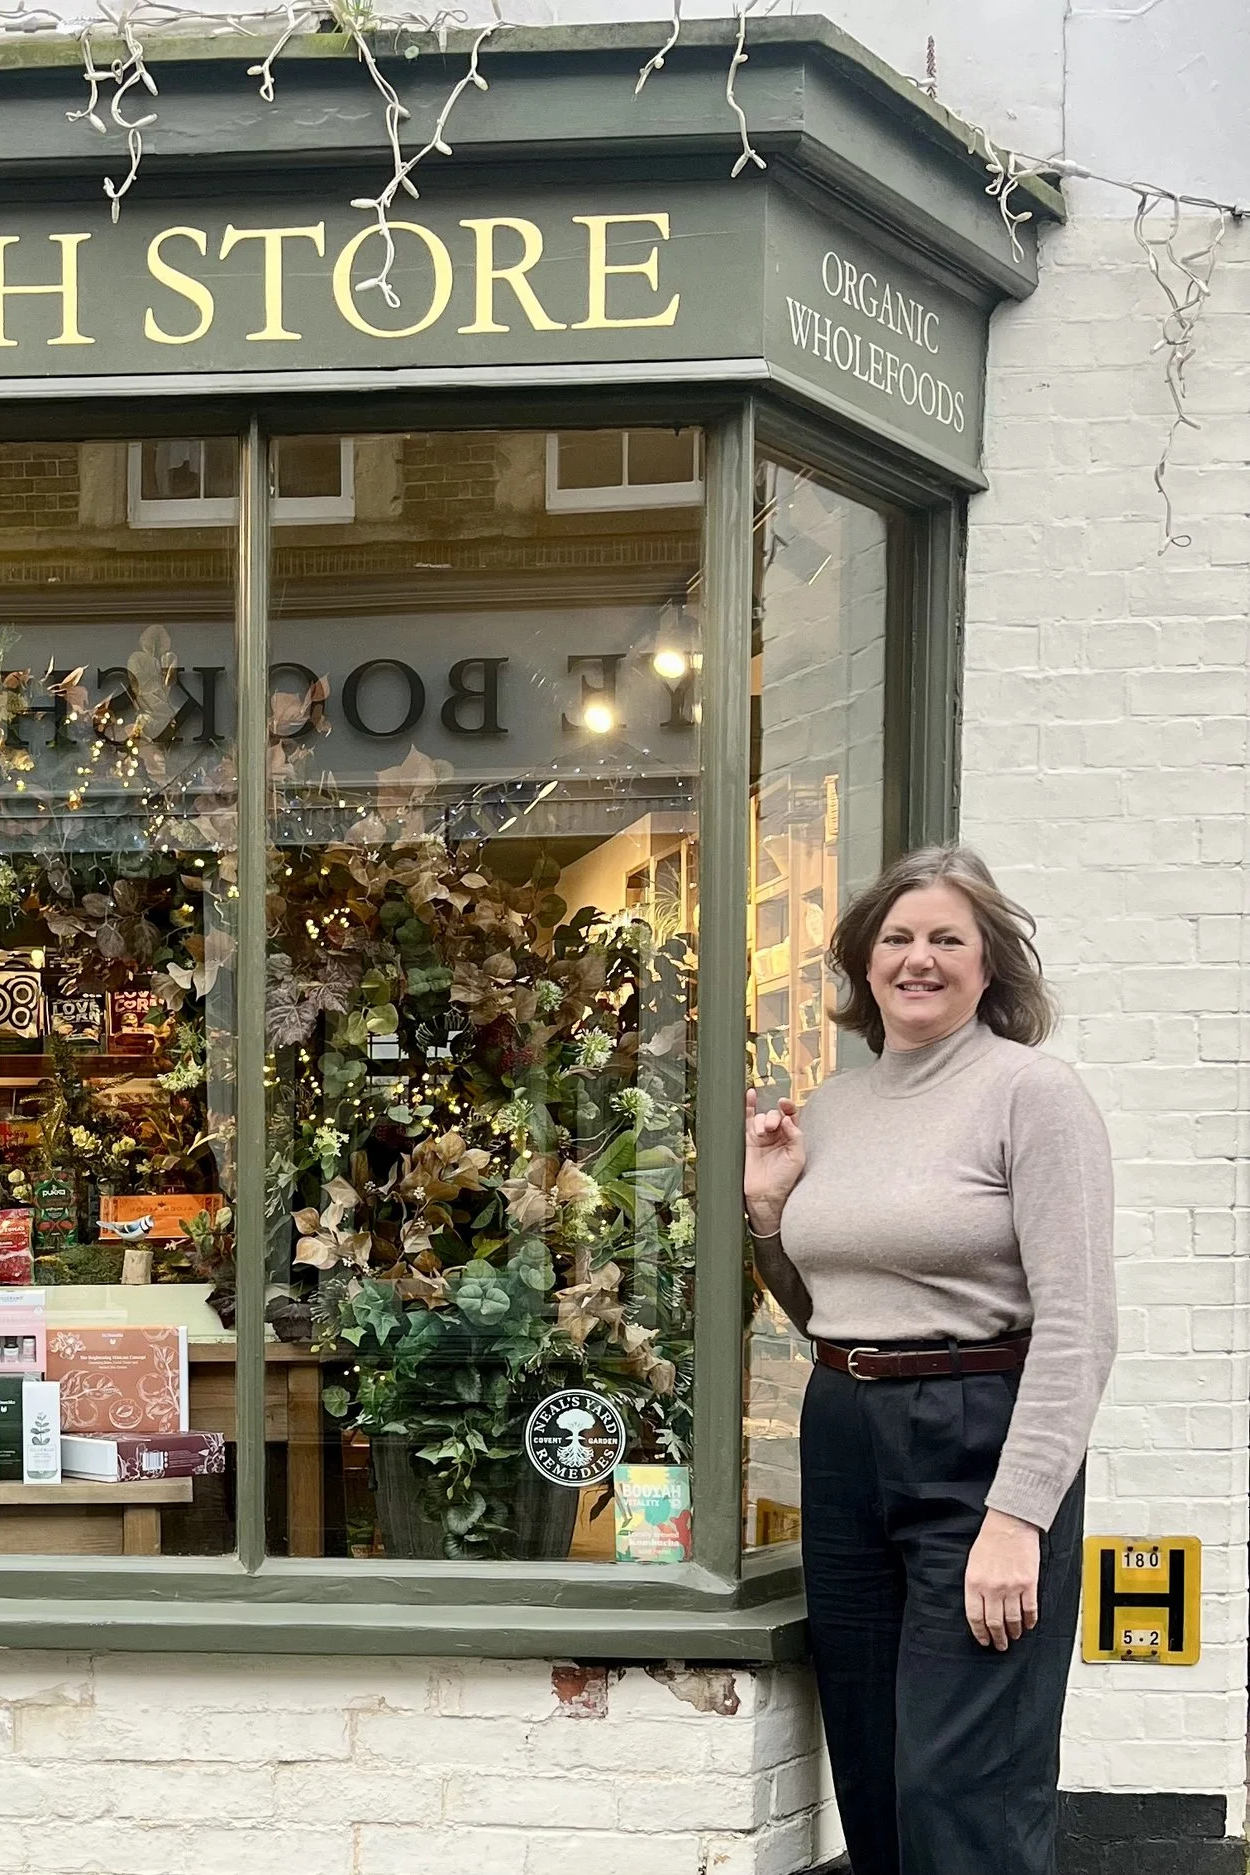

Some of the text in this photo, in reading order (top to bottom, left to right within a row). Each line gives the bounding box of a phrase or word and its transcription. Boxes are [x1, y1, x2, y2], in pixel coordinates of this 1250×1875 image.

[144, 211, 681, 345] STORE
[822, 251, 940, 354] ORGANIC
[786, 296, 965, 433] WHOLEFOODS
[534, 1396, 617, 1434] NEAL'S YARD
[533, 1436, 618, 1445] COVENT GARDEN
[536, 1447, 615, 1479] REMEDIES
[622, 1483, 682, 1498] BOOYAH
[1123, 1551, 1159, 1568] 180
[1098, 1548, 1185, 1652] H
